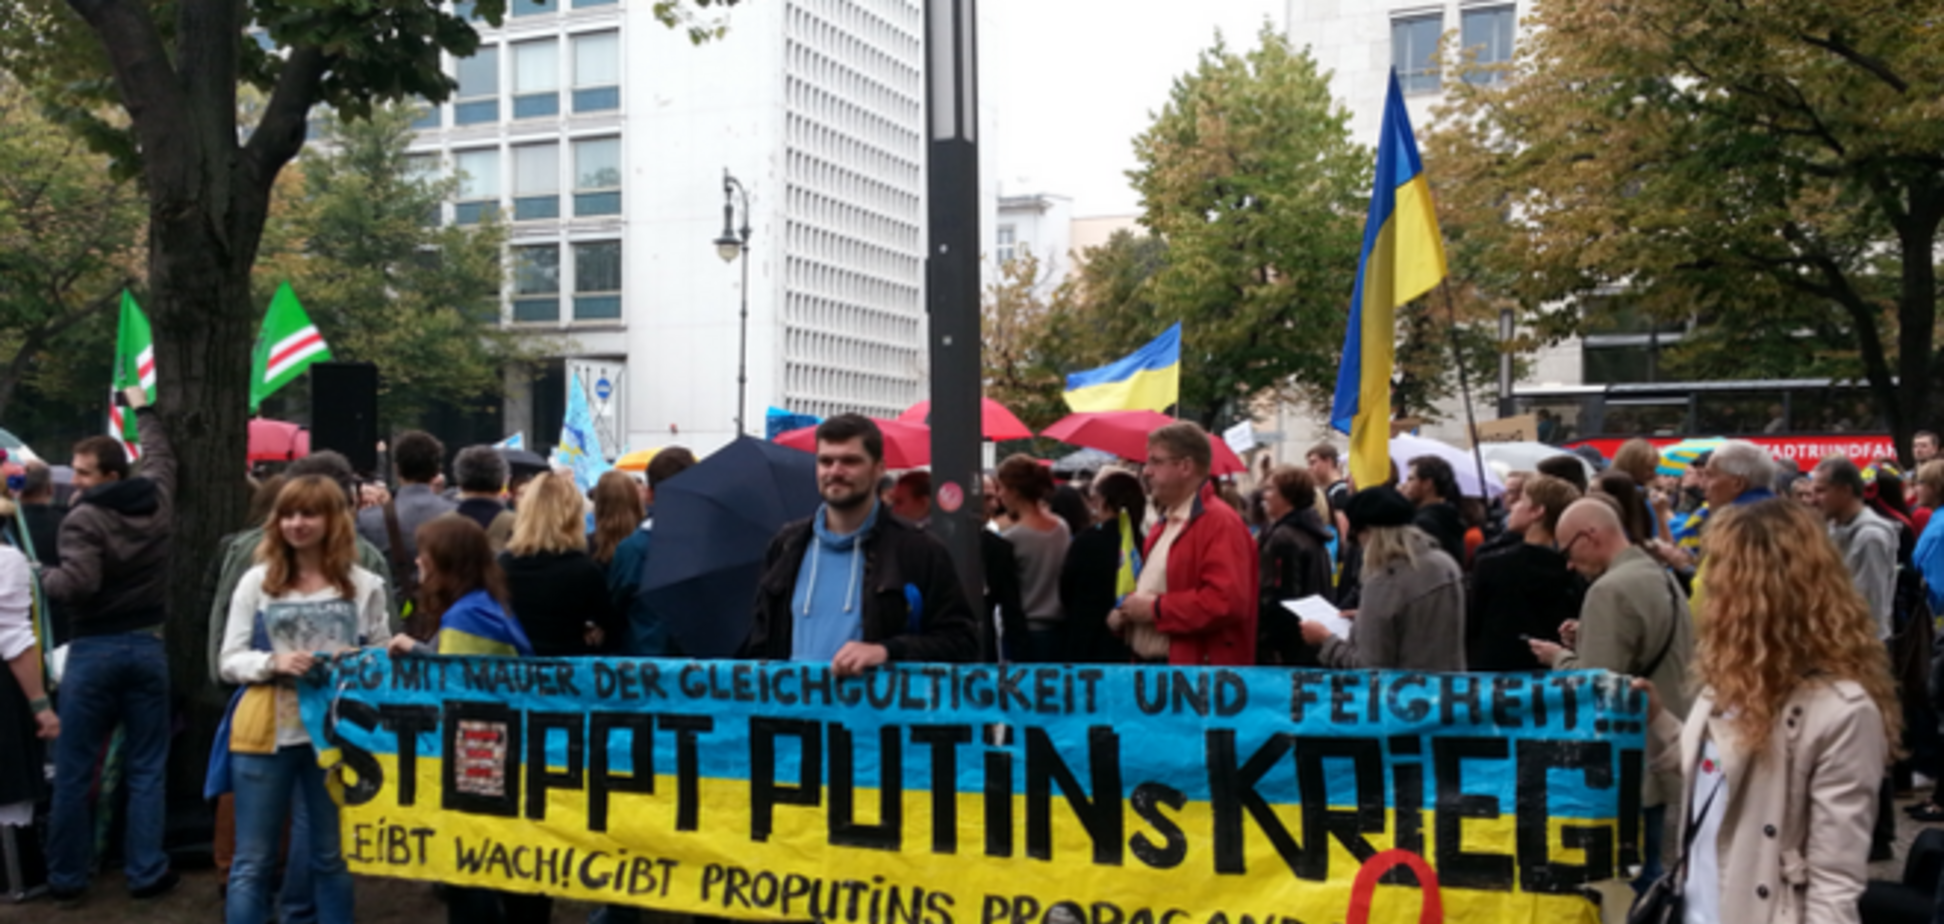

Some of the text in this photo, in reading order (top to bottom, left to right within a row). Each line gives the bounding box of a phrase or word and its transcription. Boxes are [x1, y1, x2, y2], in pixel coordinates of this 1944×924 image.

[1758, 442, 1898, 460] TADTRUNDFAH
[391, 655, 448, 692] MIT
[460, 656, 581, 697] MAUER
[593, 661, 668, 700] DER
[1133, 669, 1249, 717] UND
[323, 698, 714, 832] STOPPT
